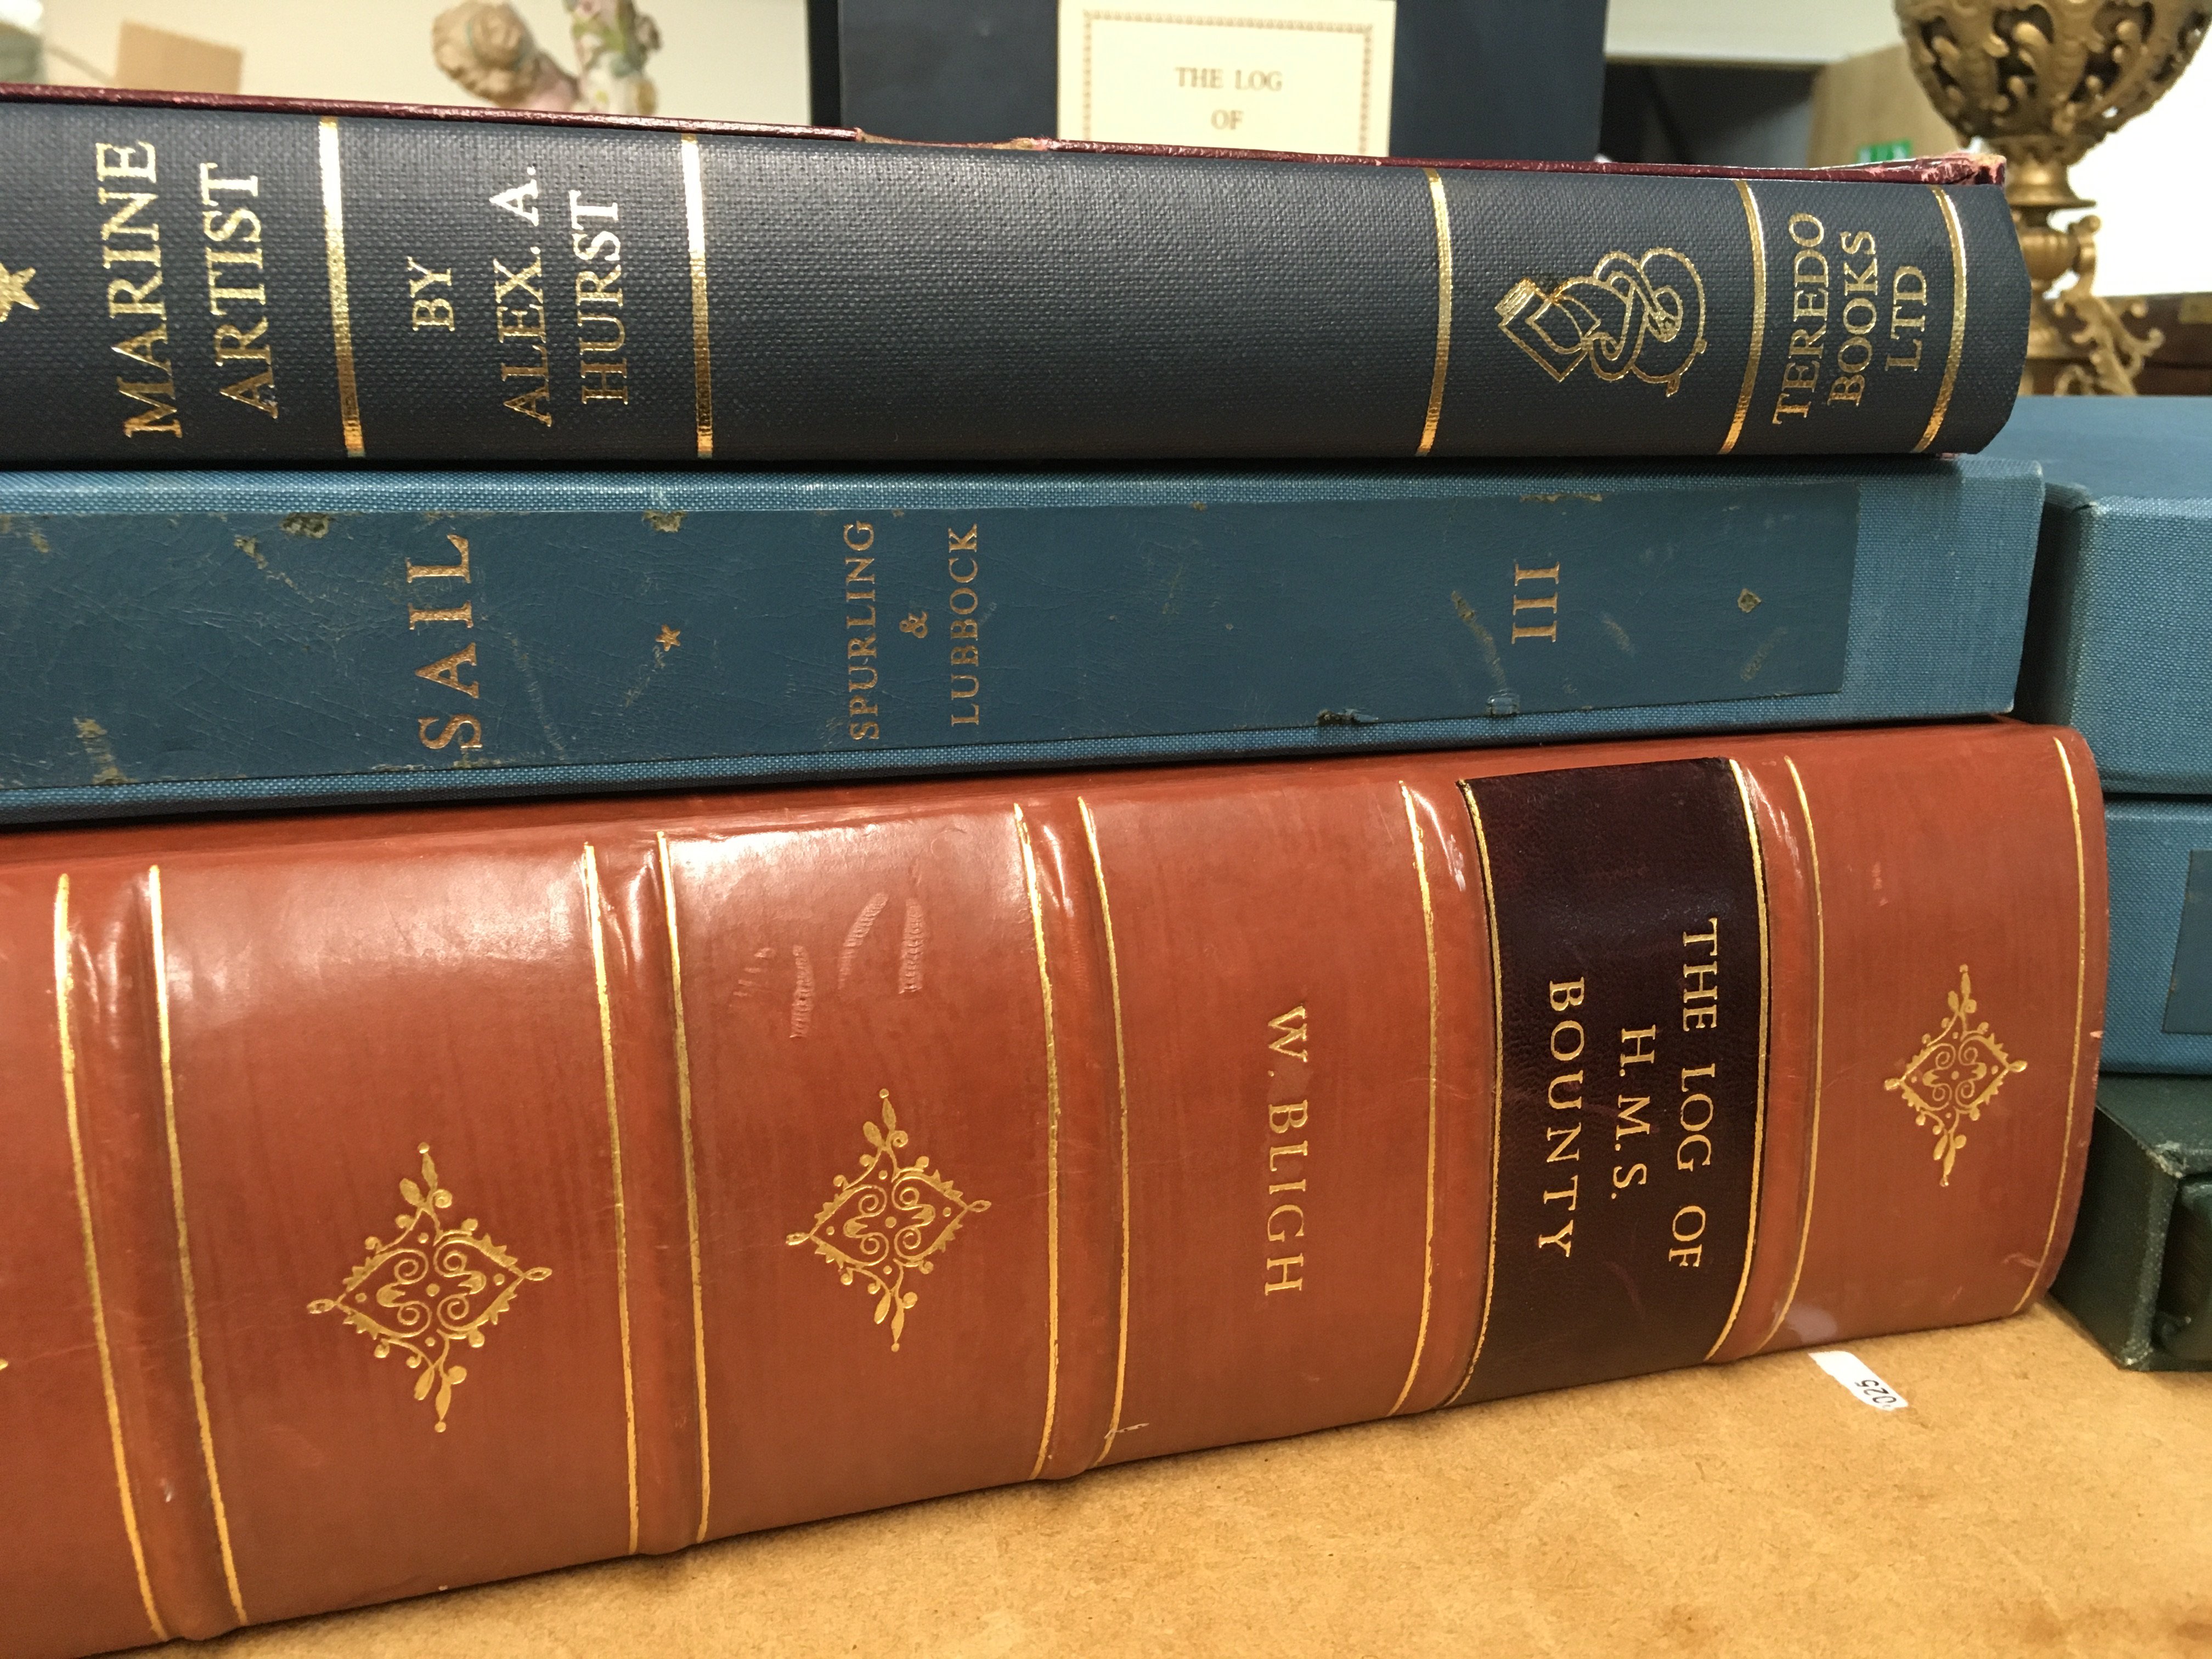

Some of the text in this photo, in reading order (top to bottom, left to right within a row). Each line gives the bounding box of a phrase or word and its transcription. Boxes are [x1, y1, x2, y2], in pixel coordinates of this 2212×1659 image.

[1174, 67, 1283, 92] THE LOG
[1211, 110, 1244, 129] OF
[96, 140, 182, 437] MARINE
[200, 163, 278, 419] ARTIST
[408, 257, 455, 331] BY
[489, 166, 552, 427] ALEX. A.
[569, 190, 628, 405] HURST
[1773, 212, 1829, 425] TEREDO
[1829, 231, 1879, 407] BOOKS
[1886, 264, 1928, 371] LTD
[406, 534, 483, 751] SAIL
[844, 520, 879, 741] SPURLING
[900, 610, 928, 639] &
[949, 523, 979, 727] LUBBOCK
[1511, 562, 1560, 644] III
[1265, 1004, 1308, 1295] W. BLIGH
[1538, 977, 1584, 1257] BOUNTY
[1668, 918, 1718, 1268] THE LOG OF
[1855, 1379, 1897, 1408] 025
